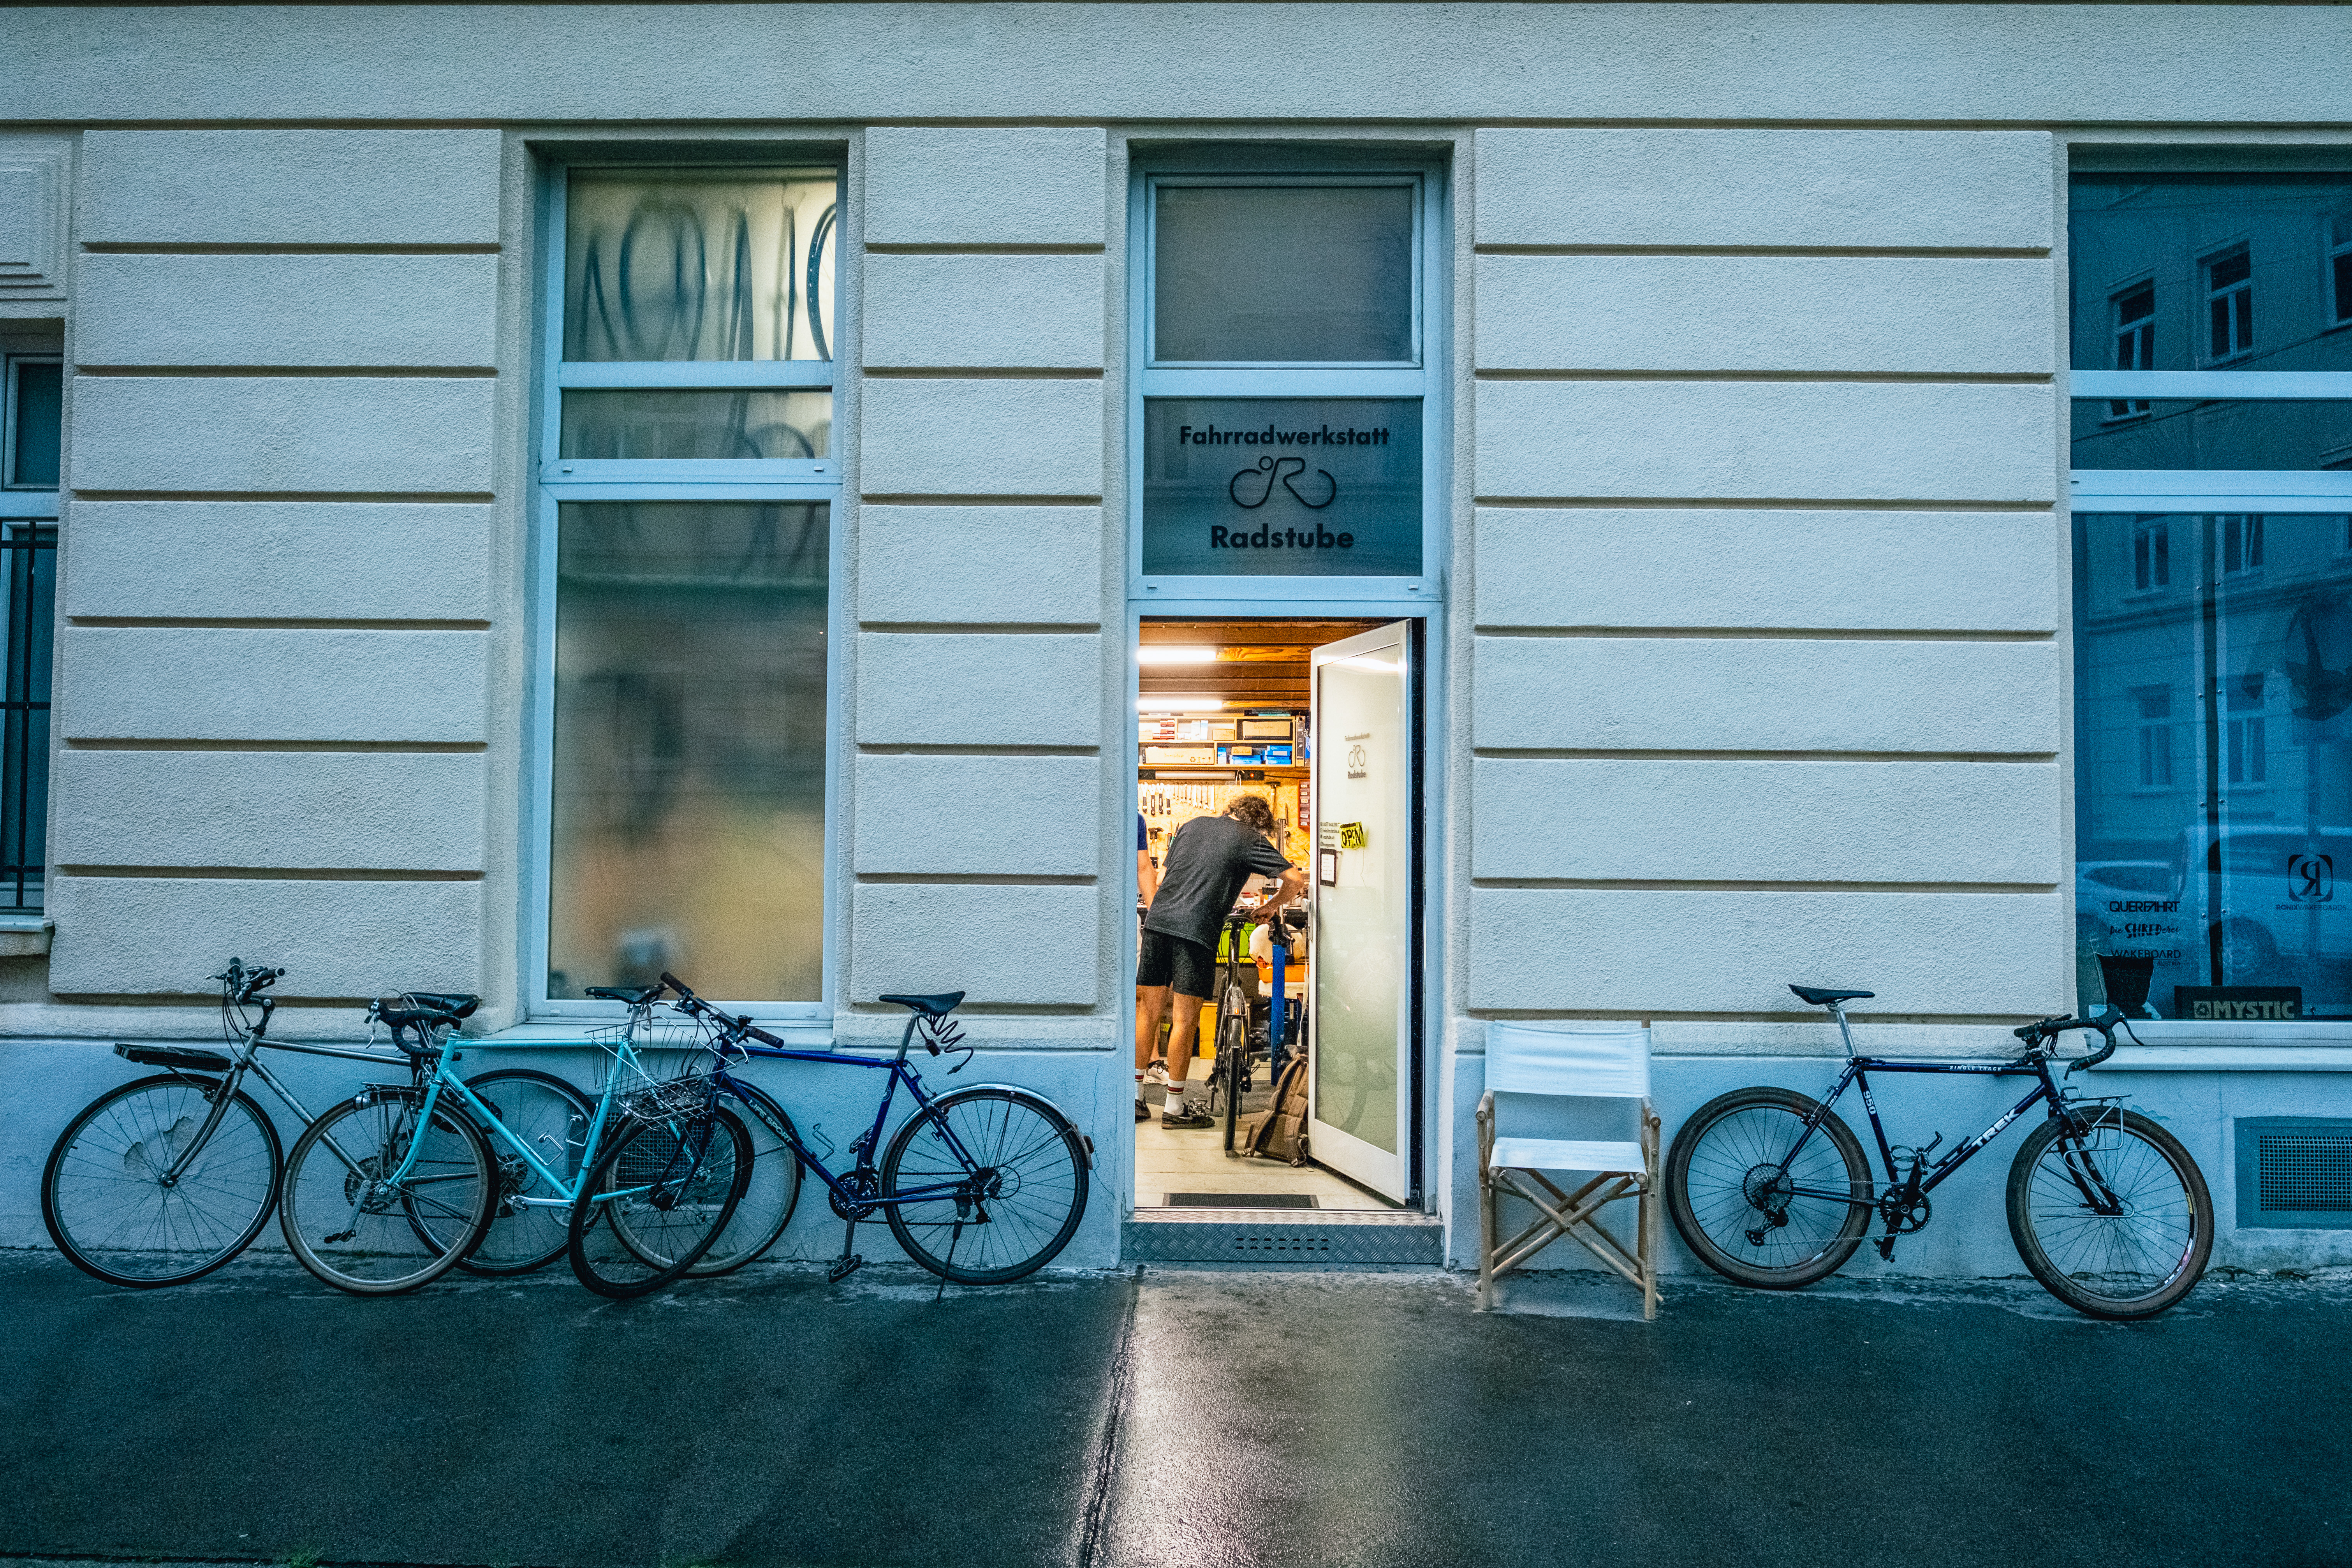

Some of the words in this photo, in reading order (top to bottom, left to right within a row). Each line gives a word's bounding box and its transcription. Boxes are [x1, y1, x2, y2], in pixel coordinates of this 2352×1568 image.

[1180, 424, 1389, 445] Fahrradwerkstatt
[1211, 523, 1354, 548] Radstube
[2109, 901, 2180, 912] QUERFAHRT
[2110, 926, 2123, 934] Die
[2111, 949, 2181, 958] WAKEBOARD
[2213, 1001, 2295, 1019] MYSTIC
[1828, 1095, 1838, 1107] USA
[1863, 1091, 1876, 1114] 950
[748, 1099, 767, 1118] LIFE
[766, 1116, 793, 1142] SPORT
[1972, 1108, 2020, 1147] TREK
